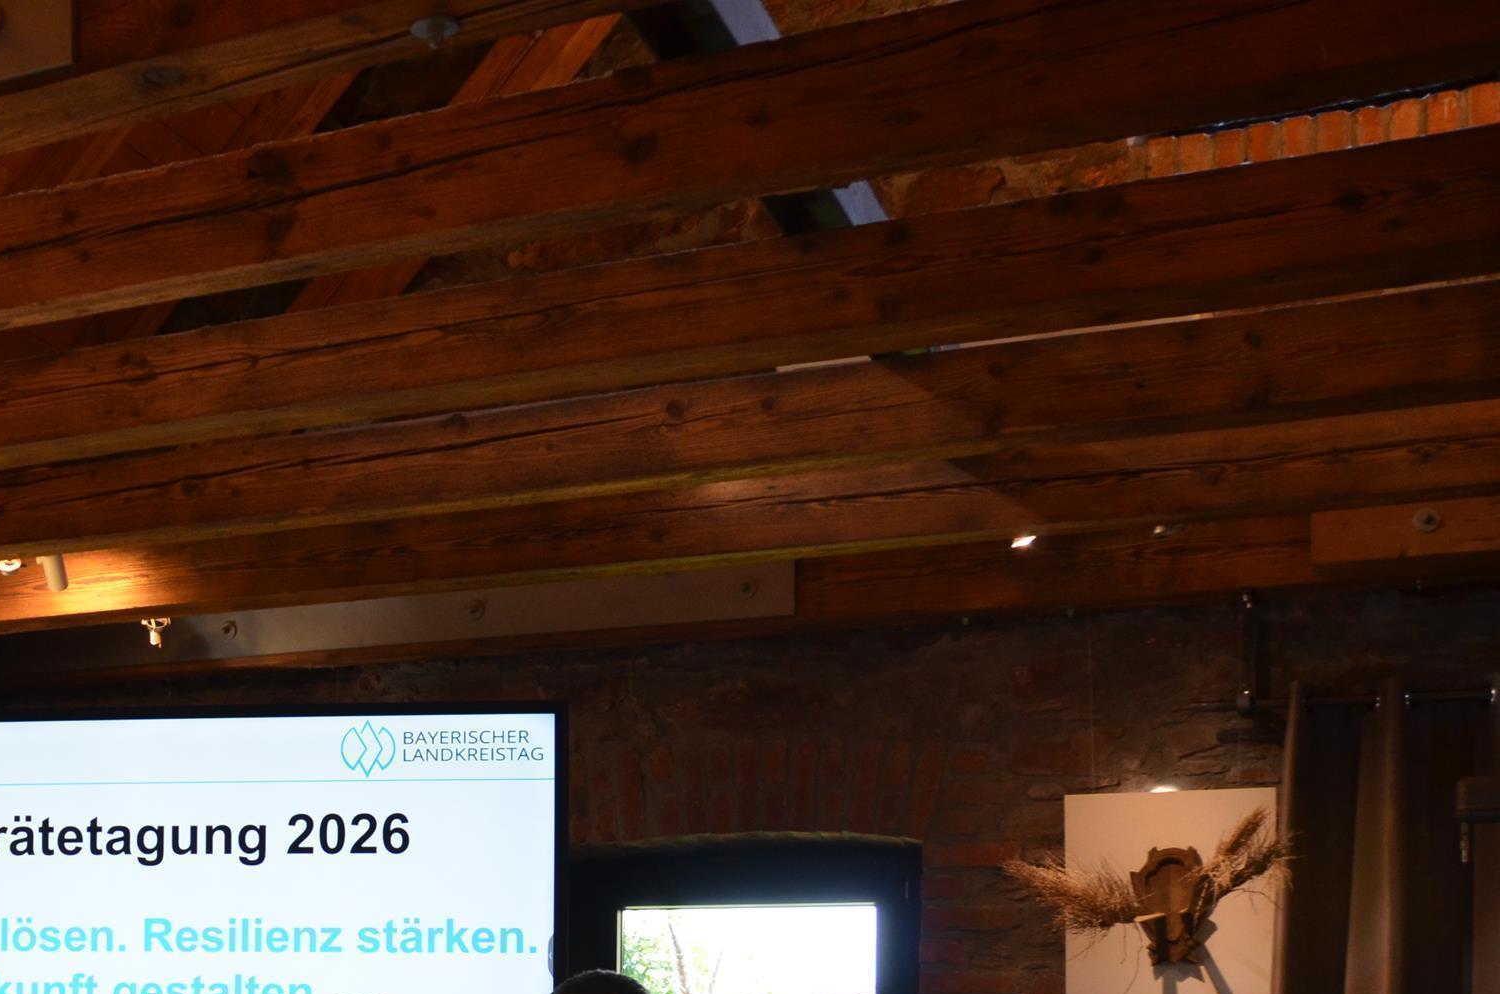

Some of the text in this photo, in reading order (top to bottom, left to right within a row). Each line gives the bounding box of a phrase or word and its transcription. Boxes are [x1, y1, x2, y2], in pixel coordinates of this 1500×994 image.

[403, 730, 529, 745] BAYERISCHER
[403, 747, 544, 762] LANDKREISTAG
[286, 812, 410, 855] 2026
[0, 916, 126, 953] lösen.
[143, 917, 343, 953] Resilienz
[356, 917, 538, 954] stärken.
